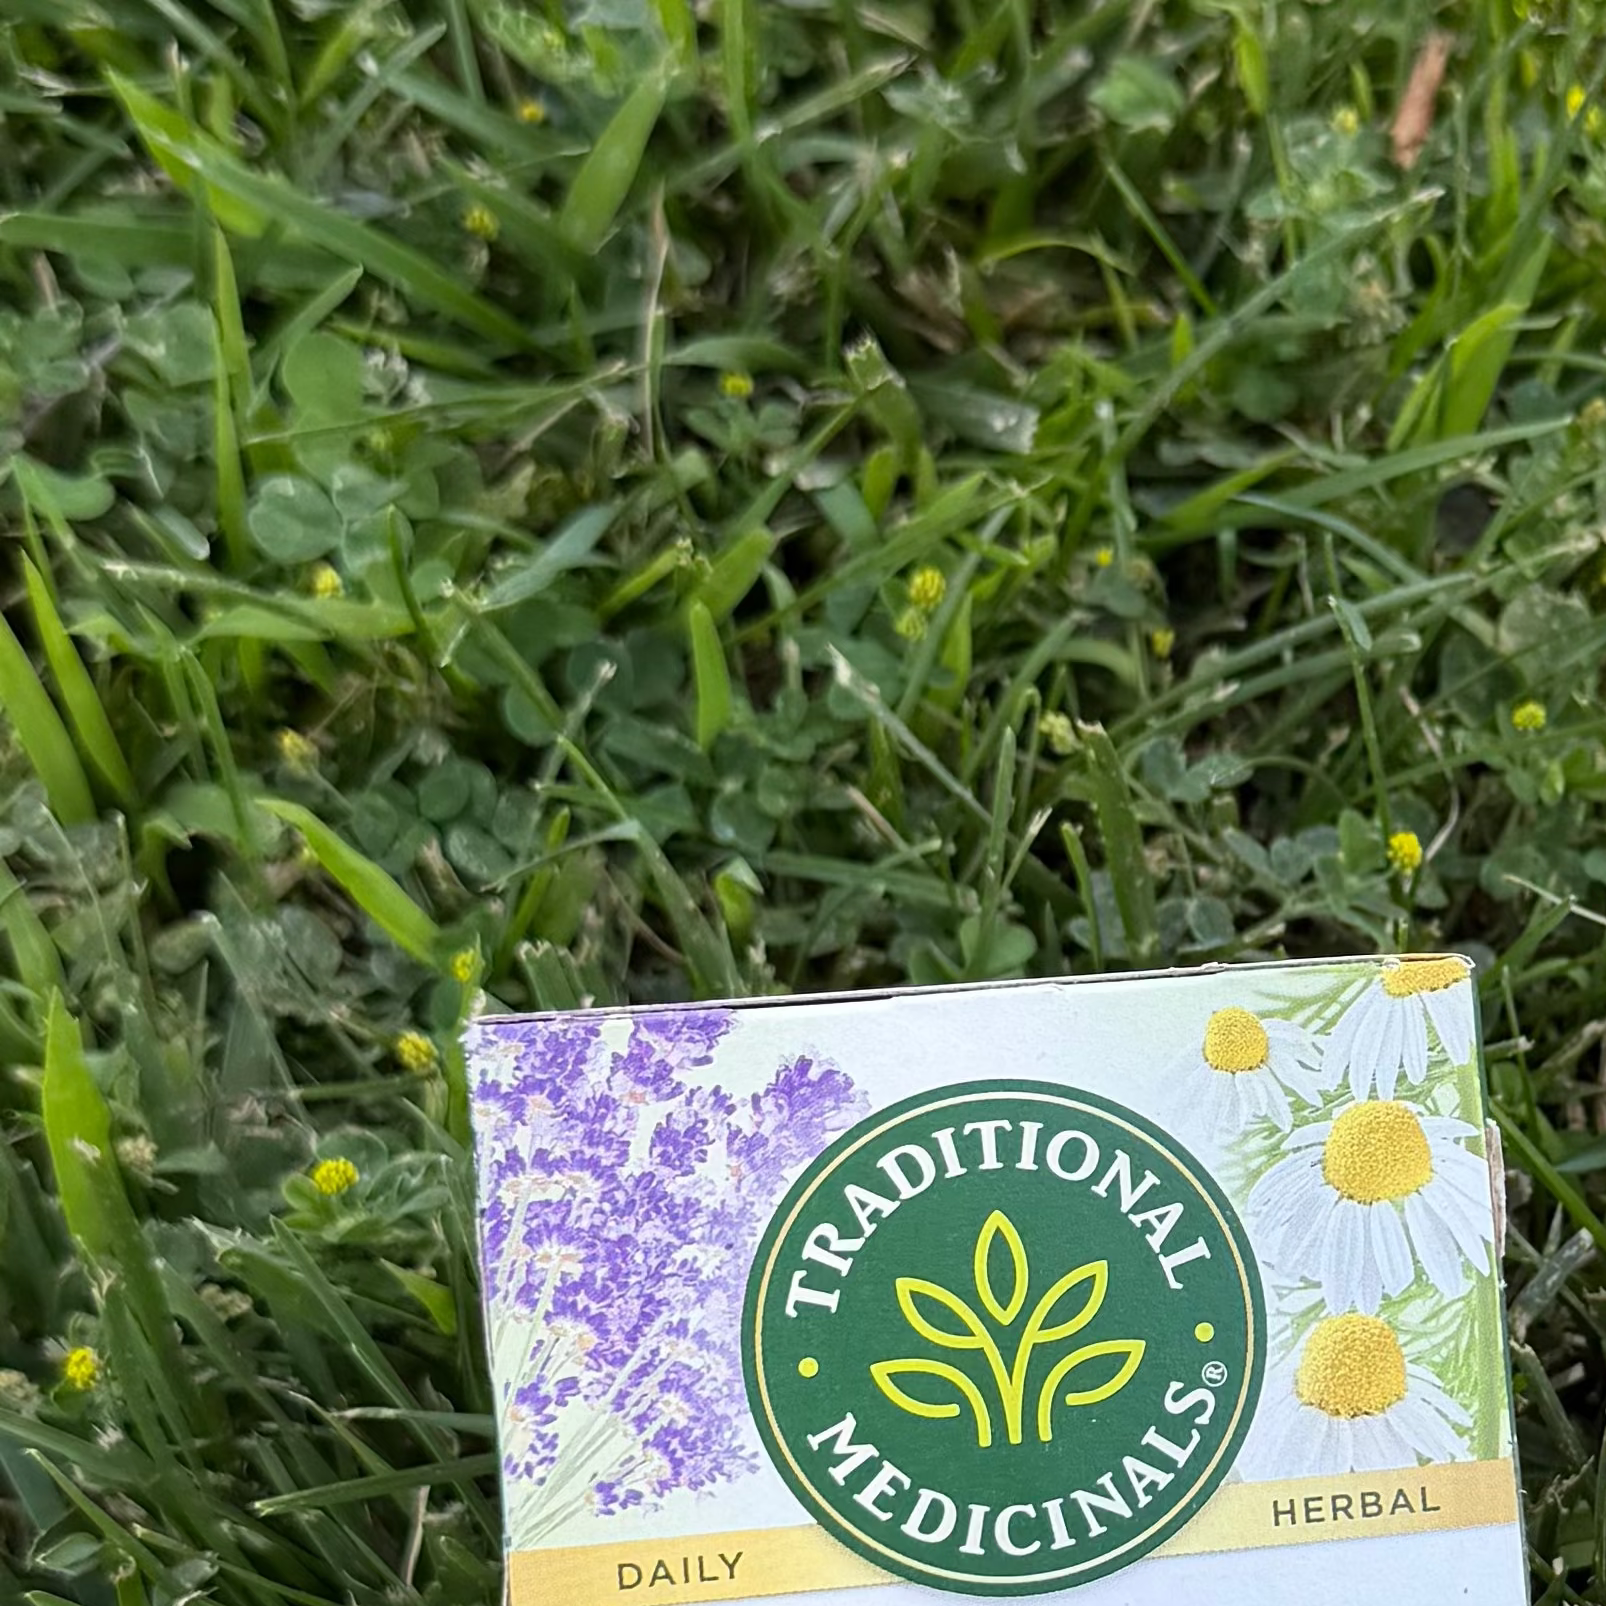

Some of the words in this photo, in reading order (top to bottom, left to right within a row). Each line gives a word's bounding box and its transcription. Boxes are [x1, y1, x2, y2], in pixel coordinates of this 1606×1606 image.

[785, 1119, 1211, 1318] TRADITIONAL
[1272, 1486, 1440, 1527] HERBAL
[617, 1551, 743, 1591] DAILY
